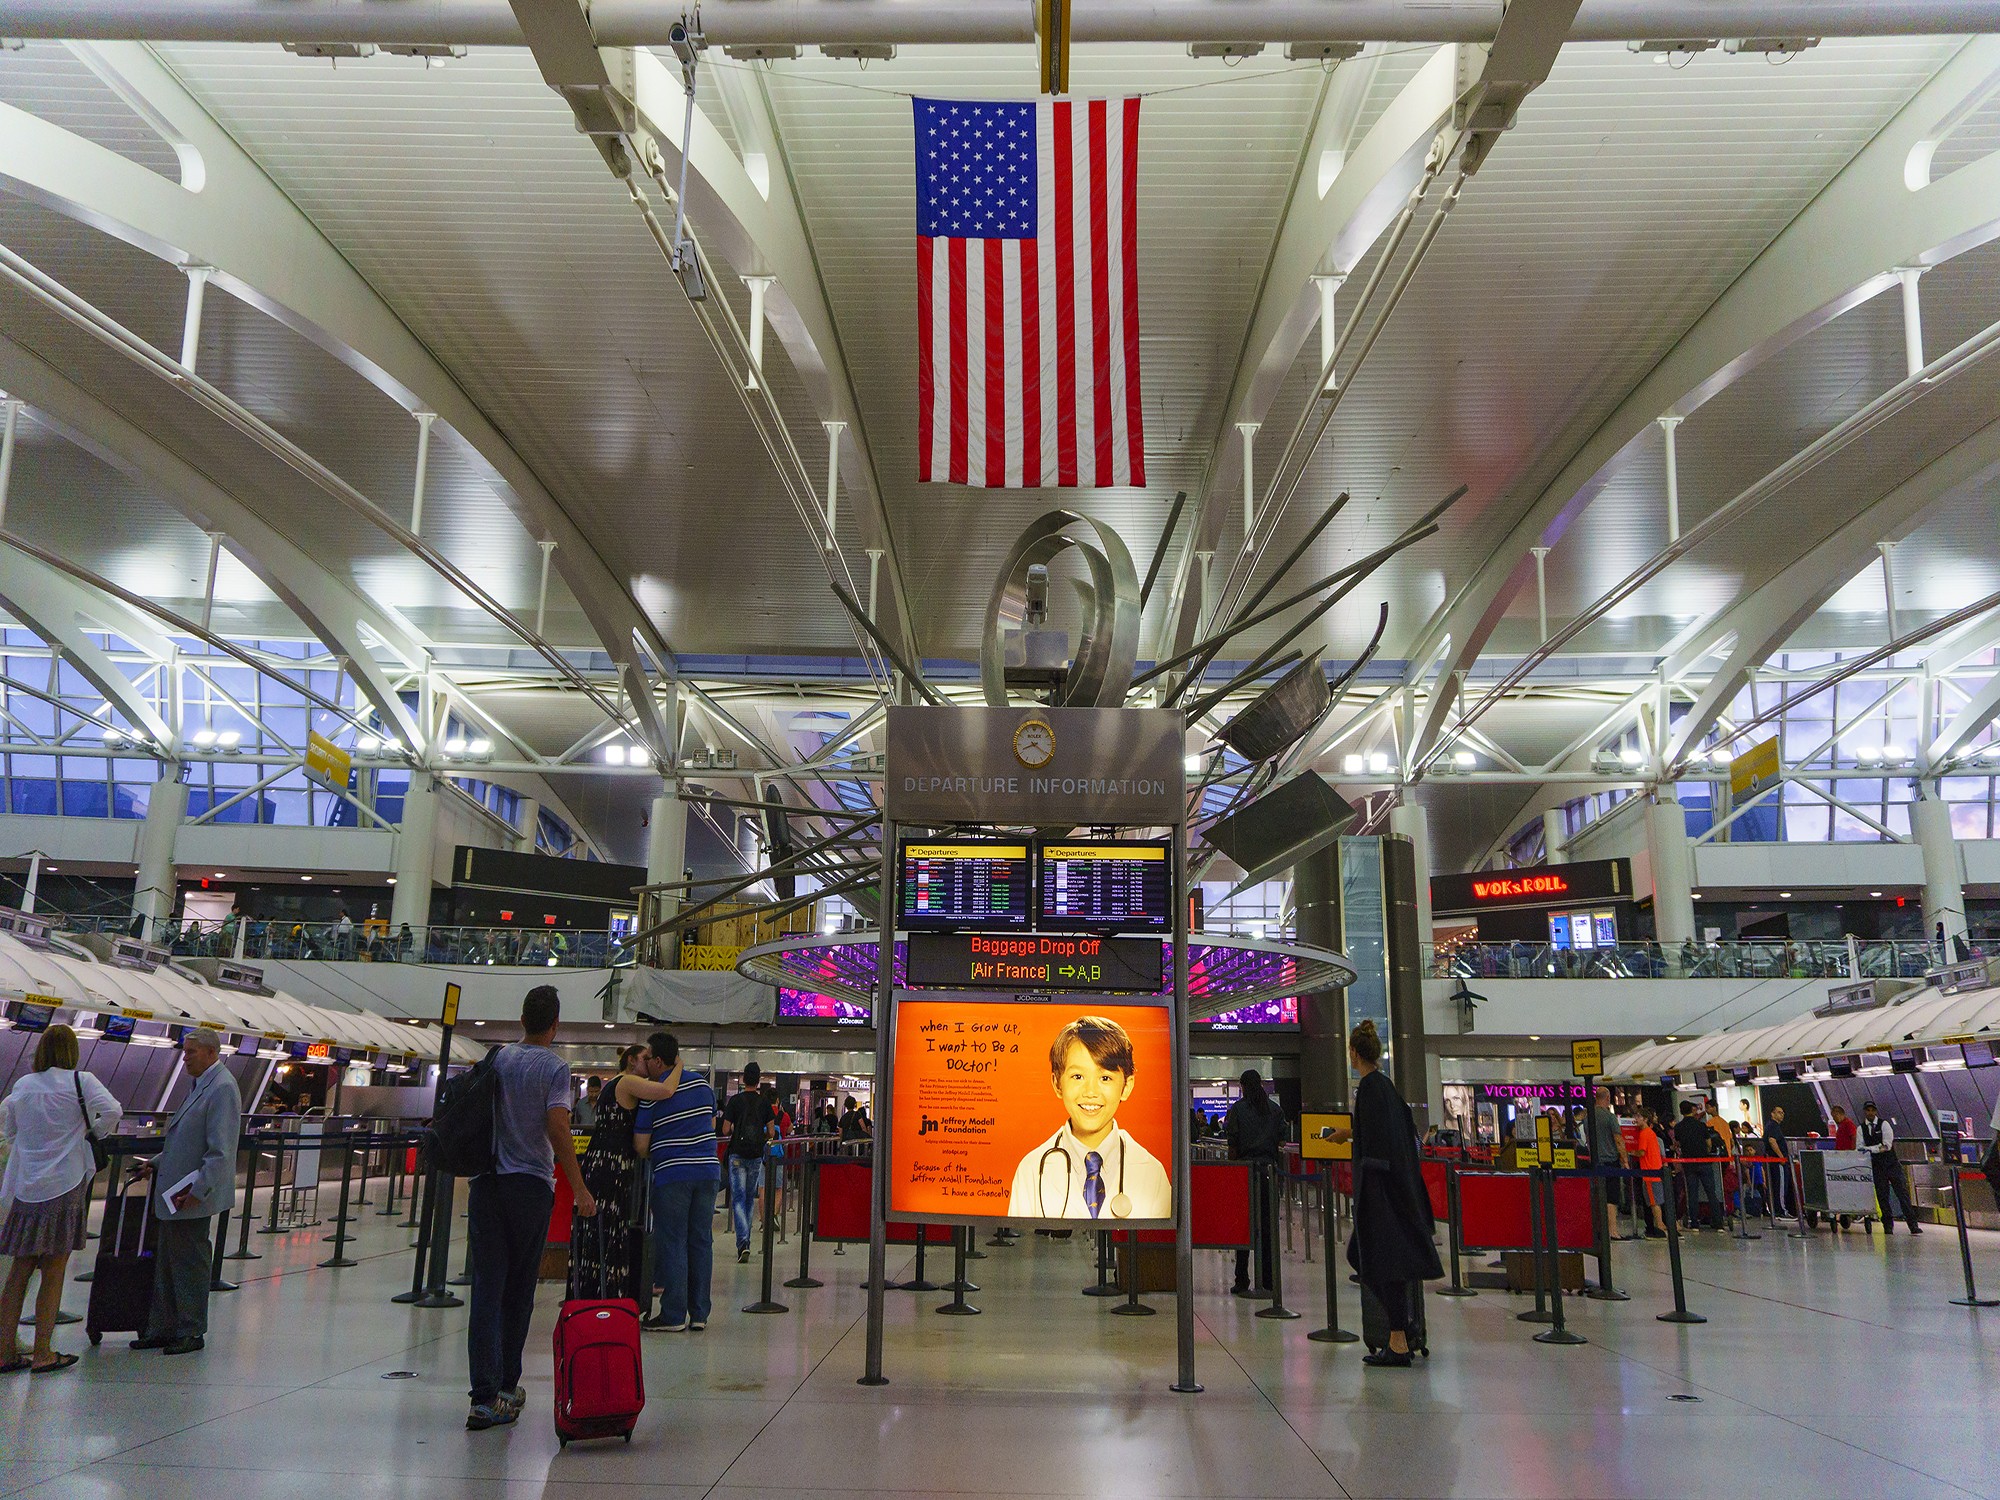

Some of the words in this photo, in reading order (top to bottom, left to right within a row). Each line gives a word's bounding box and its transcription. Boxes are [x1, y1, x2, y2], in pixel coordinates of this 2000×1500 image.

[904, 777, 1019, 793] DEPARTURE
[1030, 778, 1166, 795] INFORMATION
[918, 848, 958, 857] Departures
[1056, 850, 1097, 858] Departures
[971, 938, 1036, 956] Baggage
[1041, 939, 1075, 957] Drop
[1080, 940, 1101, 955] Off
[971, 962, 994, 980] [Air
[997, 963, 1050, 981] France]
[1077, 965, 1101, 983] A,B
[920, 1020, 949, 1033] when
[955, 1022, 964, 1033] I
[926, 1039, 936, 1052] I
[939, 1040, 967, 1053] want
[992, 1041, 1005, 1053] Be
[1010, 1045, 1019, 1053] a
[857, 1080, 870, 1088] FREE
[1484, 1084, 1555, 1098] VICTORIA'S
[918, 1114, 939, 1136] jm
[941, 1117, 967, 1127] Jeffrey
[969, 1118, 995, 1126] Modell
[944, 1126, 987, 1134] Foundation
[914, 1161, 940, 1172] Because
[944, 1162, 952, 1172] of
[956, 1164, 967, 1172] the
[910, 1172, 936, 1183] Jeffrey
[965, 1173, 1003, 1185] Foundation
[1827, 1174, 1859, 1182] TERMINAL
[942, 1187, 949, 1196] I
[952, 1188, 968, 1197] have
